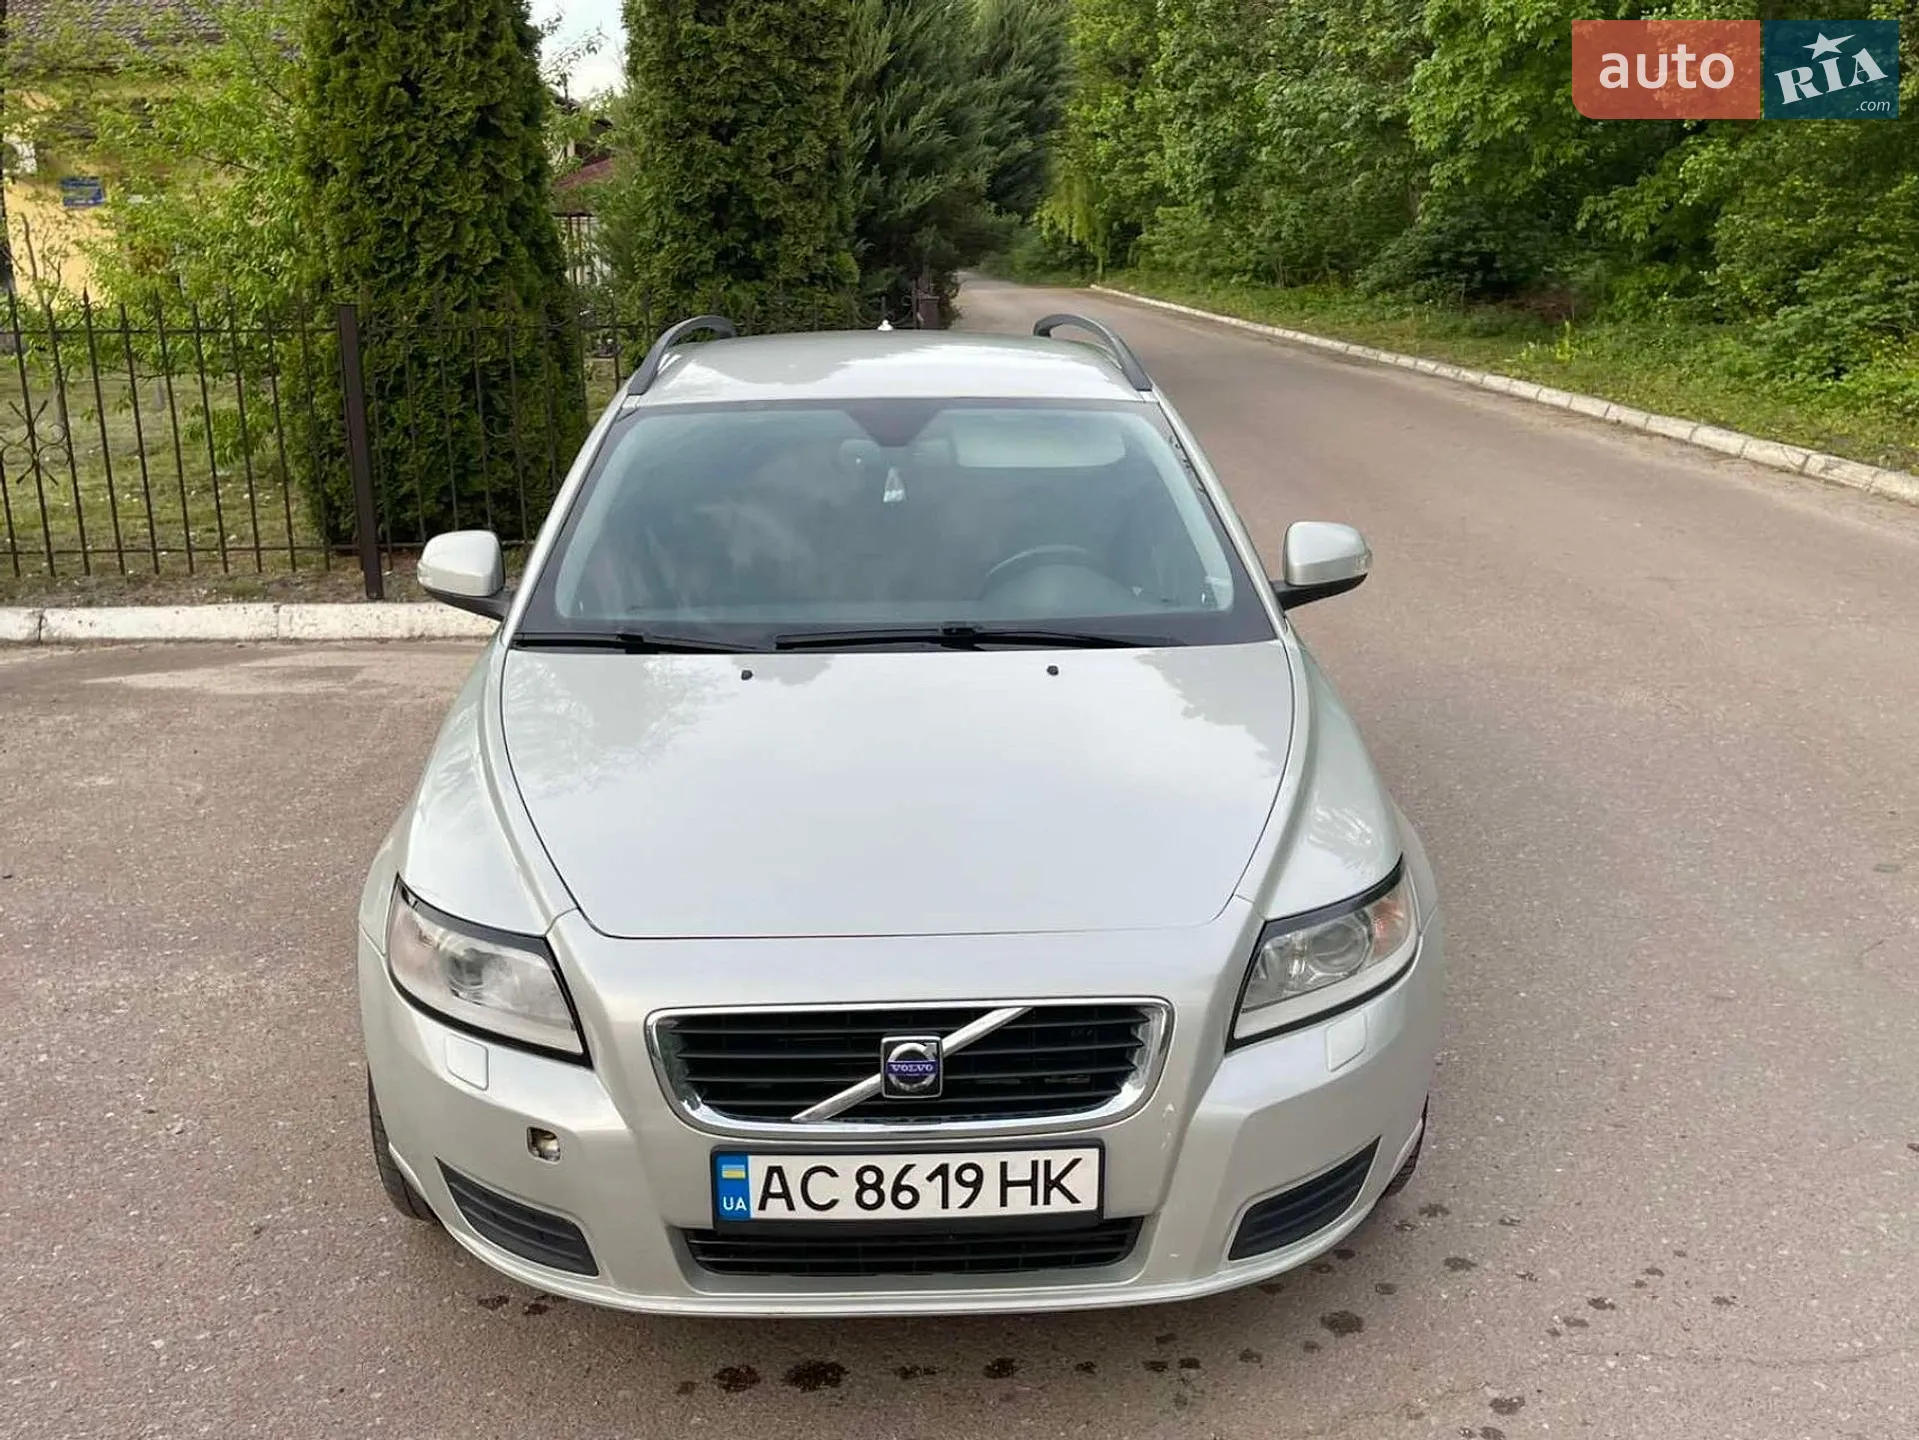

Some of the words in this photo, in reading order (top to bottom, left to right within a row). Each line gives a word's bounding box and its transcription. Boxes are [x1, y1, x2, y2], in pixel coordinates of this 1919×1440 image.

[889, 1063, 934, 1072] VOLVO
[757, 1164, 840, 1212] AC
[854, 1162, 985, 1211] 8619
[999, 1157, 1084, 1208] HK
[722, 1197, 748, 1212] UA
